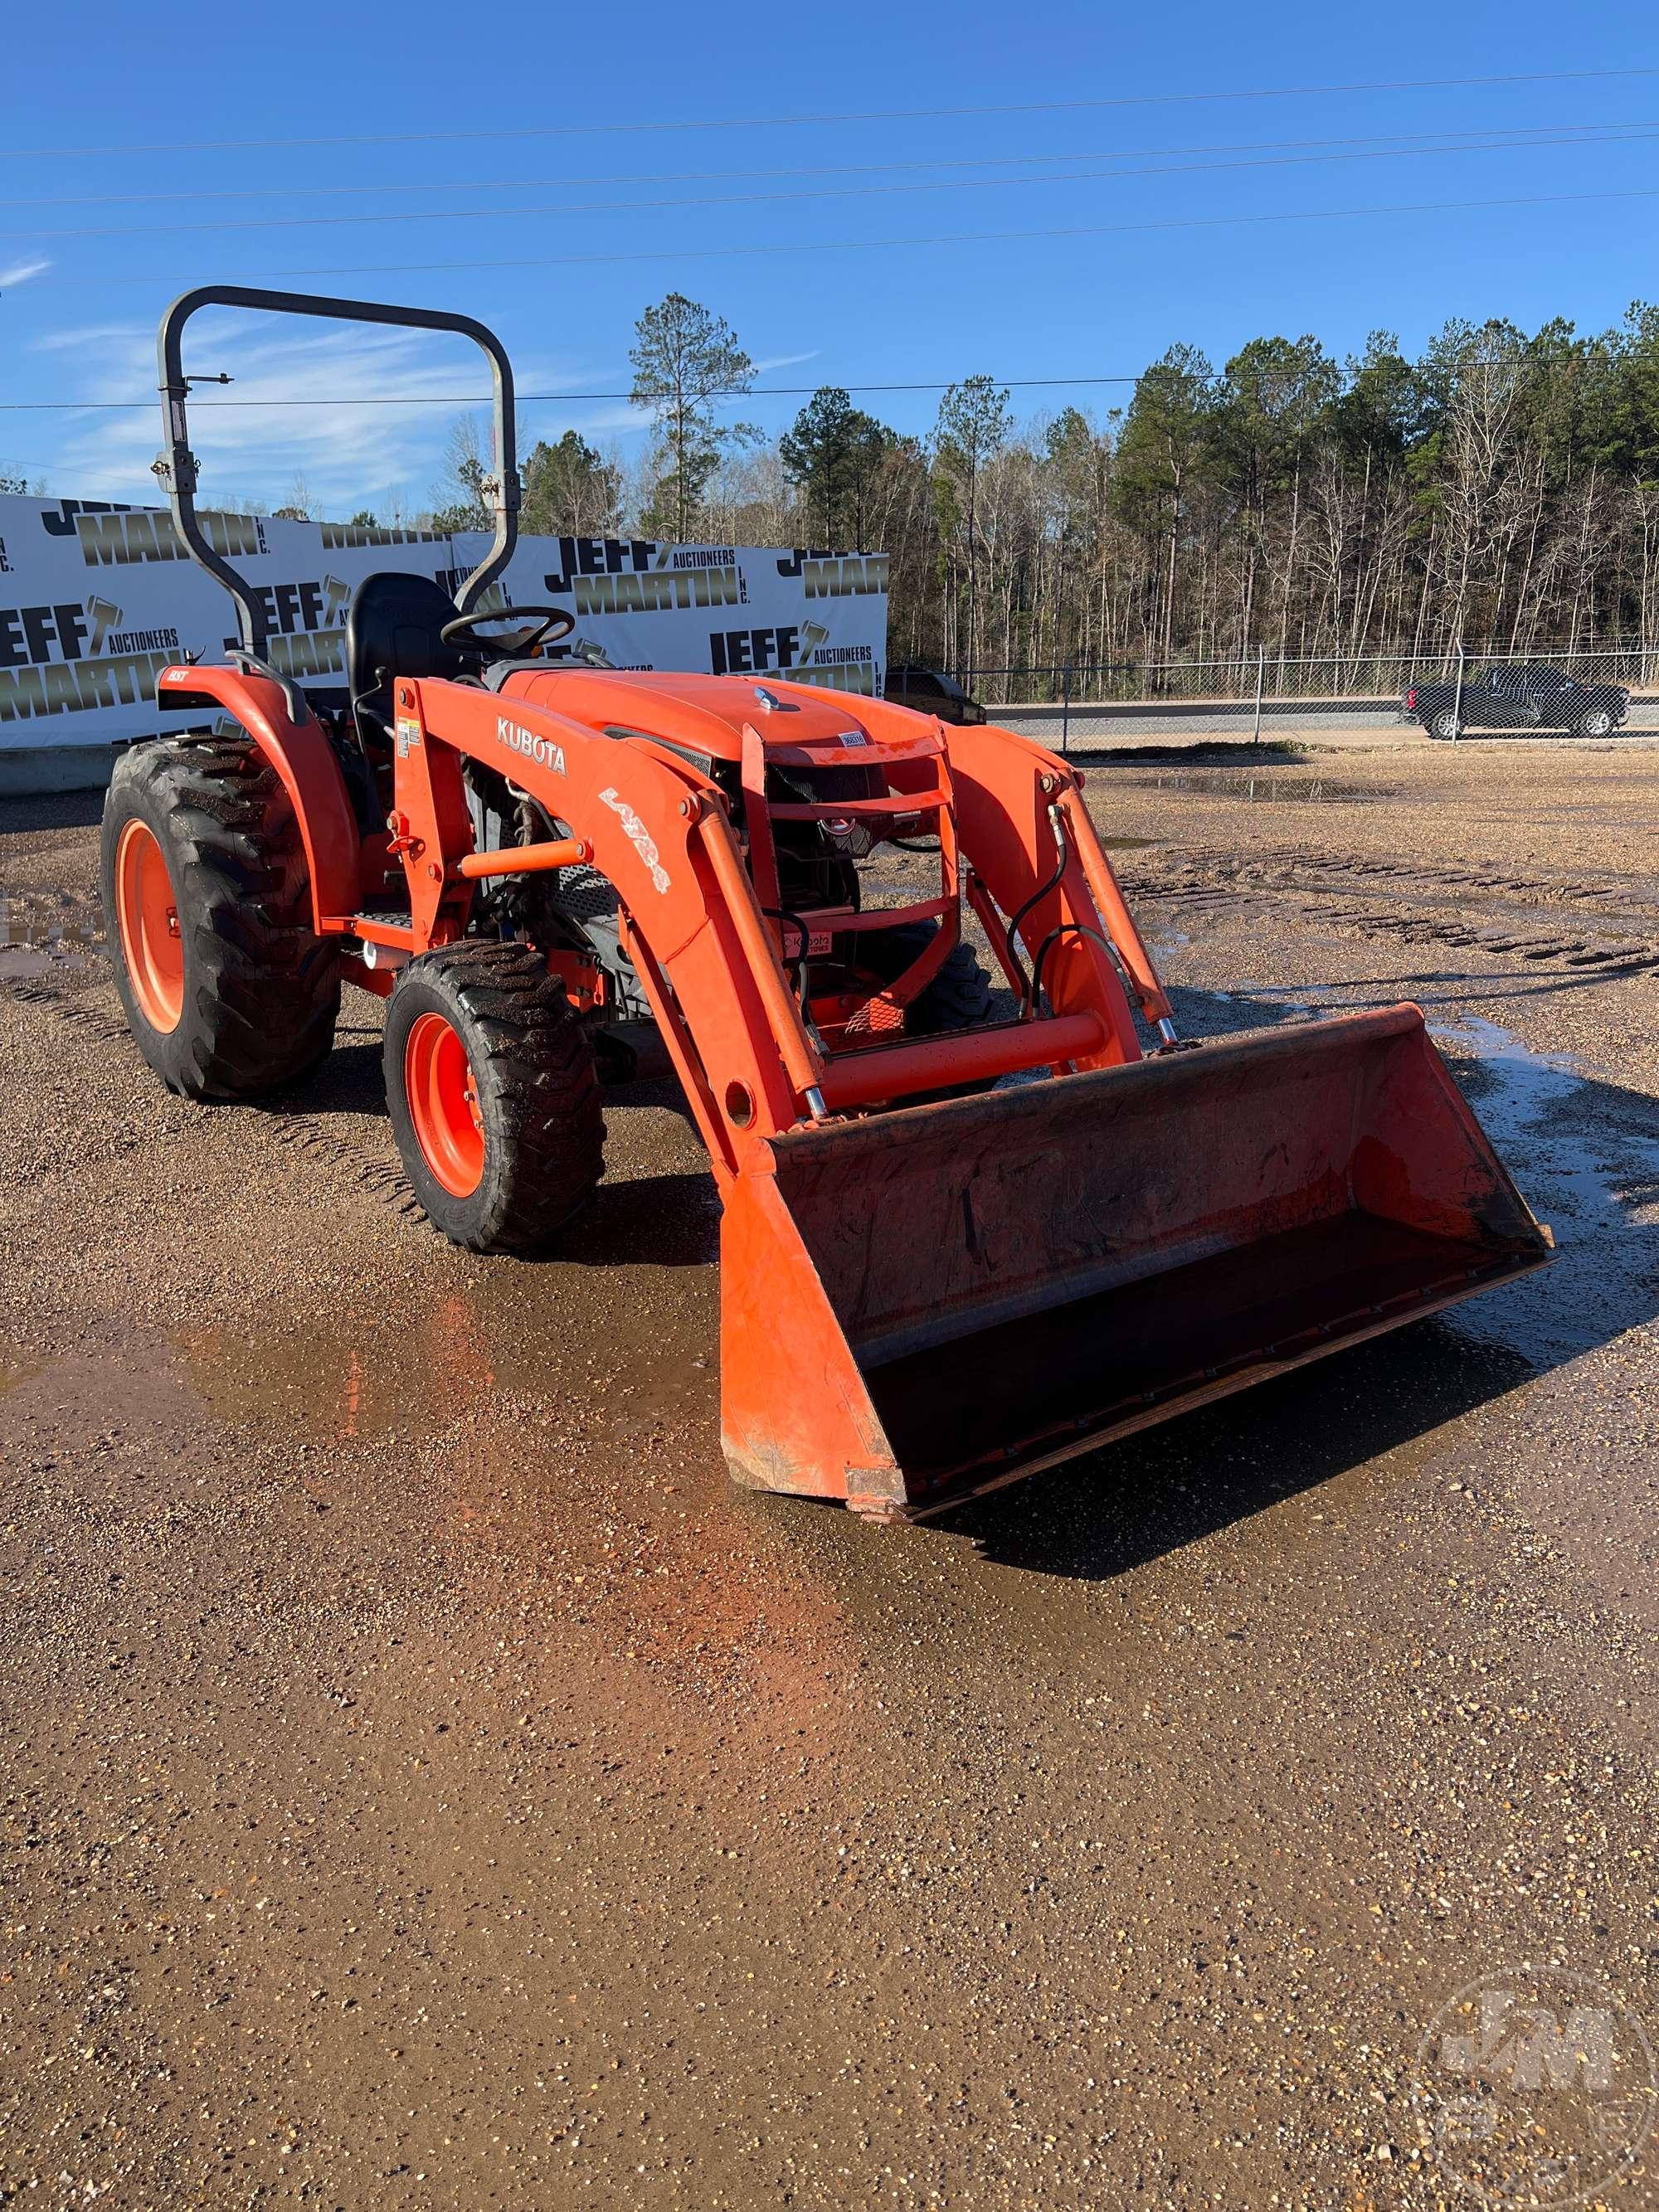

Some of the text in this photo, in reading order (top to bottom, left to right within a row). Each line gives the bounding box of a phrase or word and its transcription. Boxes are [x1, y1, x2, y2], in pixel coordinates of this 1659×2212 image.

[673, 549, 736, 570] AUCTIONEERS
[573, 566, 737, 616] MARTIN
[108, 628, 179, 654] AUCTIONEERS
[814, 645, 872, 665] AUCTIONEERS
[497, 716, 567, 779] KUBOTA
